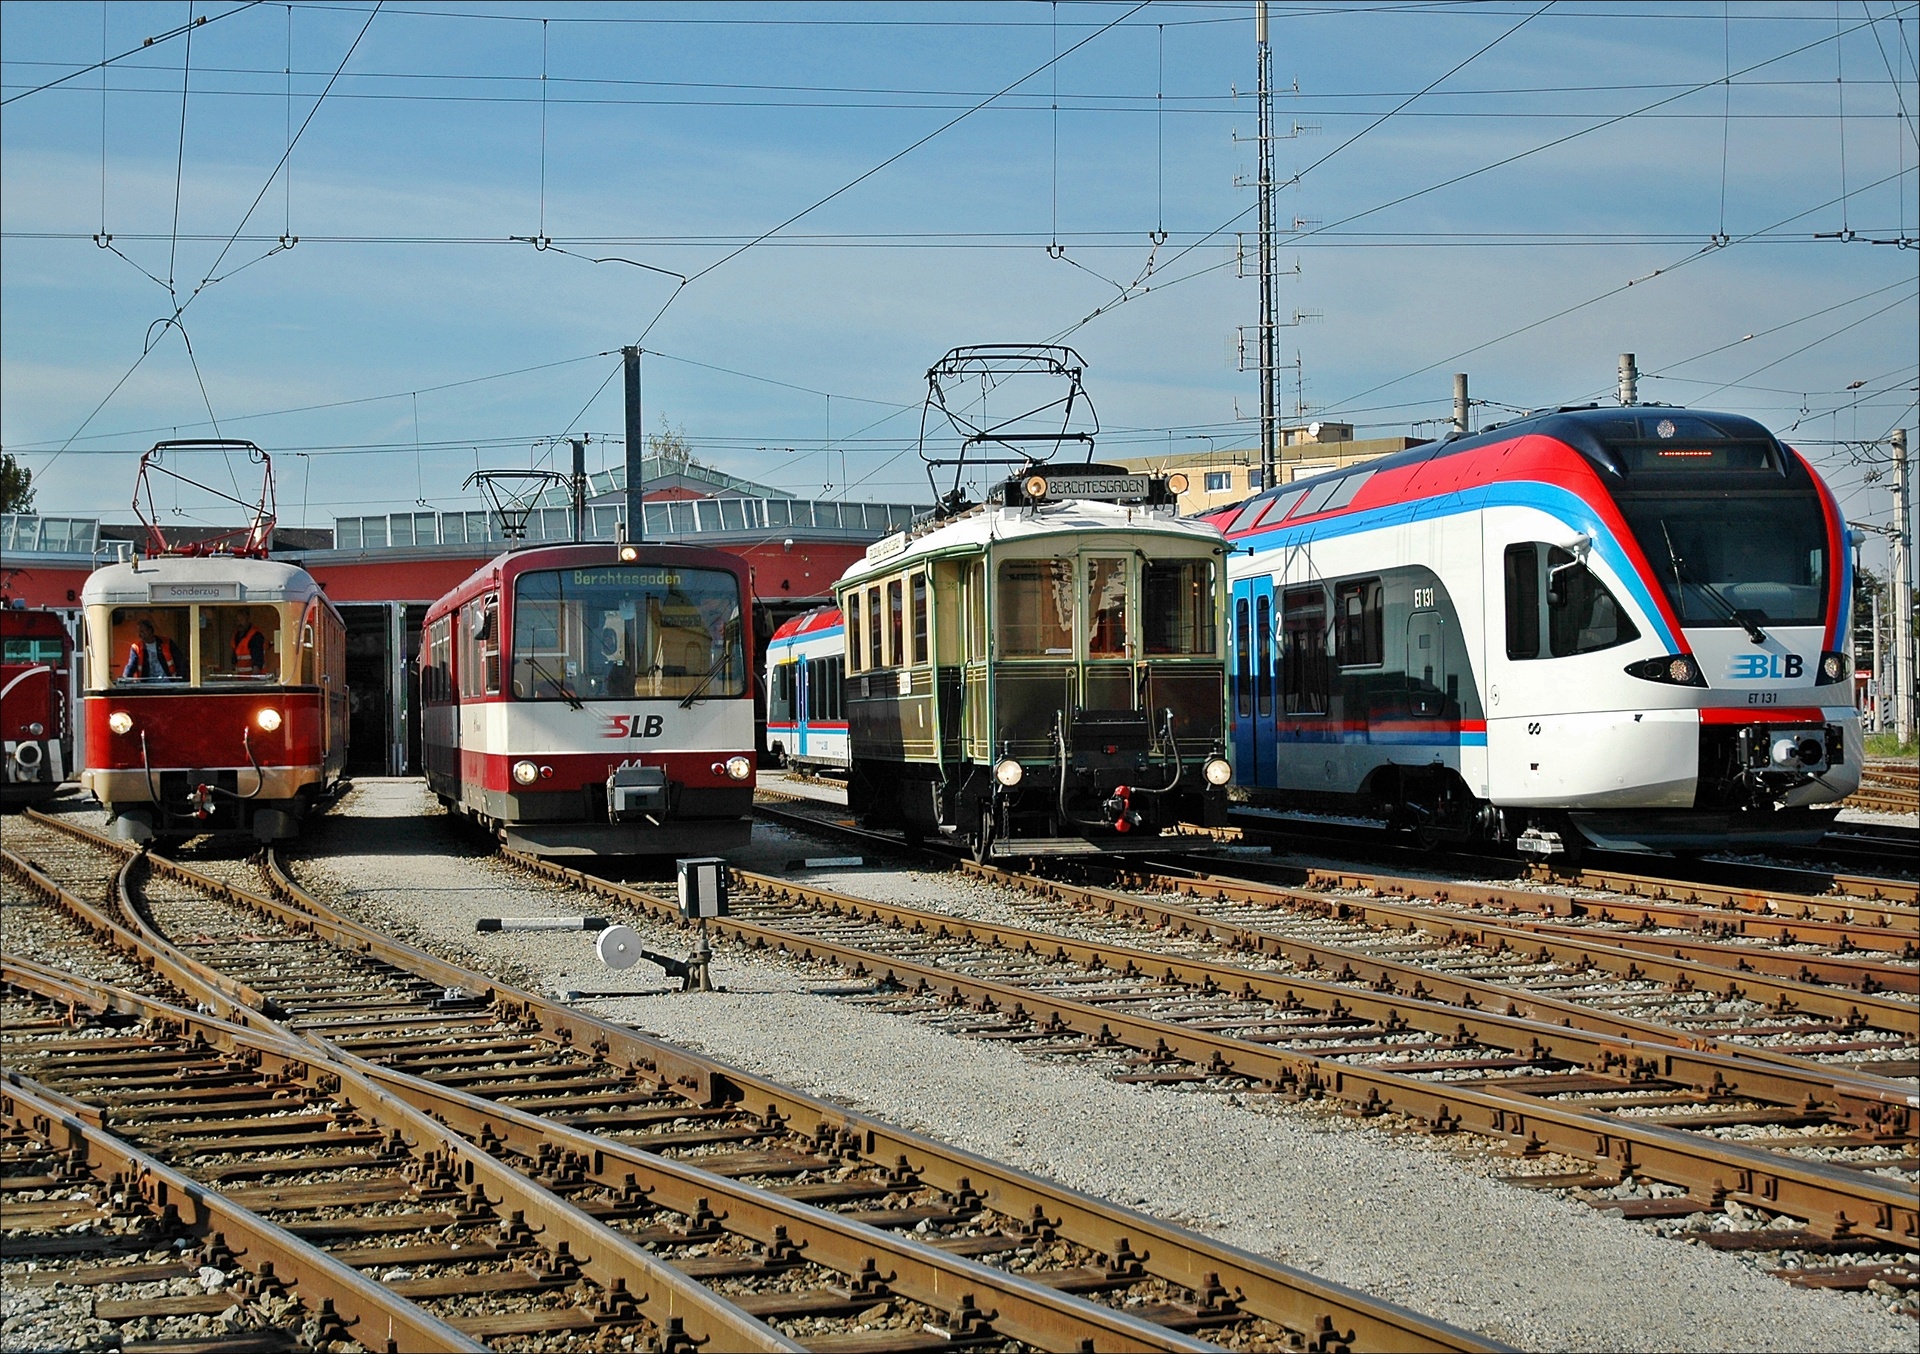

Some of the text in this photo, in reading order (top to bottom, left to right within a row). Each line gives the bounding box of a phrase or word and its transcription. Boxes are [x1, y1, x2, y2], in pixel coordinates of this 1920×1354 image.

[1050, 480, 1144, 494] BERCHTESGADEN
[574, 570, 681, 586] Berchtesgaden
[781, 579, 790, 591] 4
[66, 589, 76, 602] 8
[170, 586, 220, 597] Sonderzug
[1422, 587, 1434, 607] 131
[1275, 611, 1283, 642] 2
[1729, 654, 1803, 678] BLB
[1748, 693, 1777, 704] ET 131
[603, 714, 664, 738] SLB
